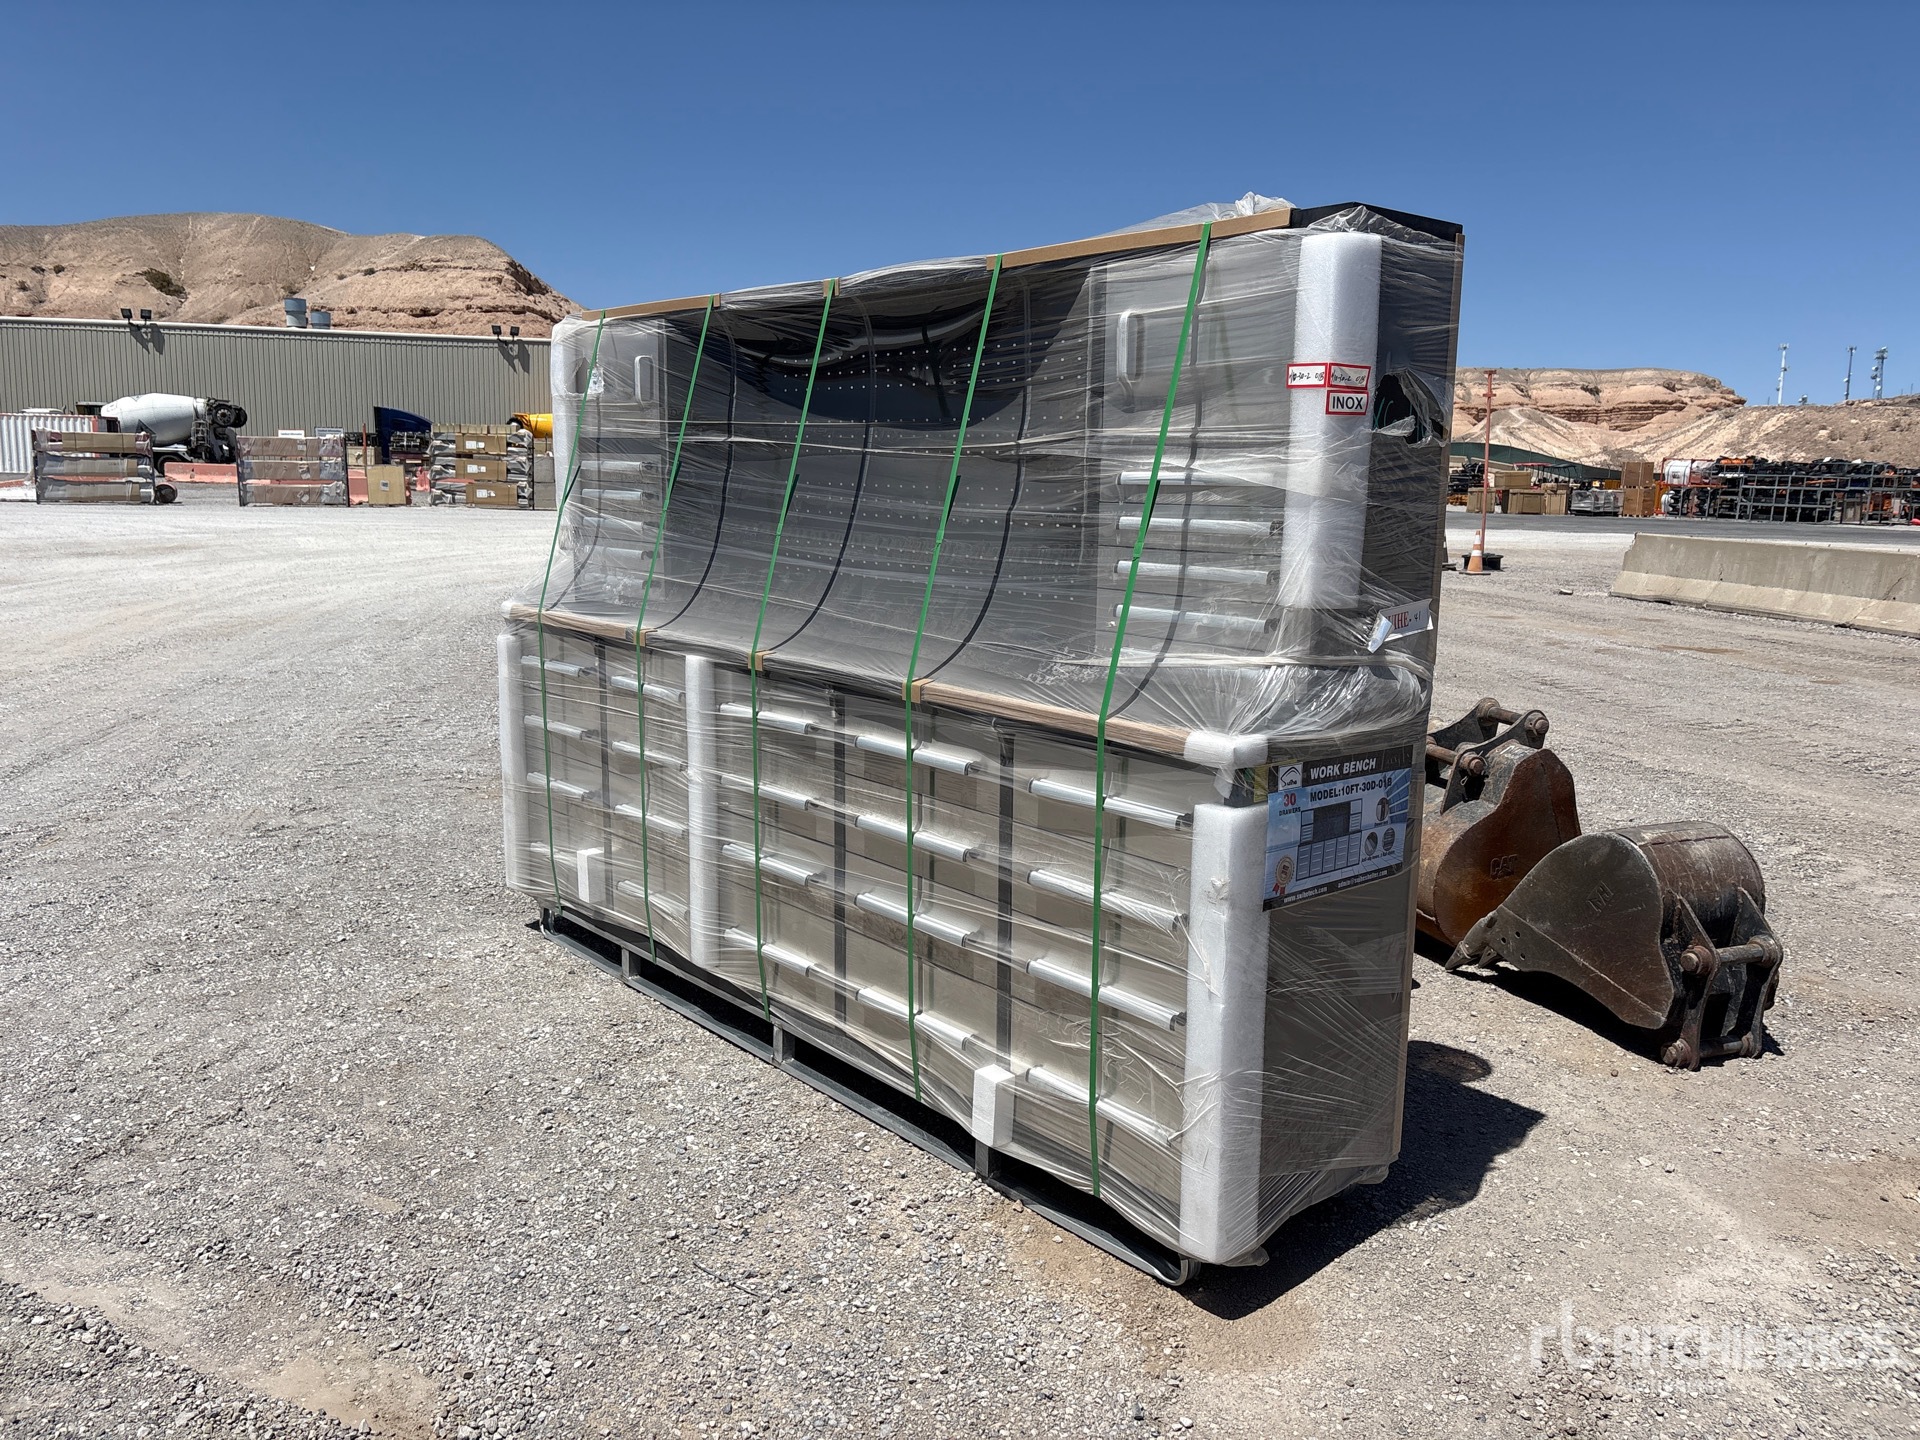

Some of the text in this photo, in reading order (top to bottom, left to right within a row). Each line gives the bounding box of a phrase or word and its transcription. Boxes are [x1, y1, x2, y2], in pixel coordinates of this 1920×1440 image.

[1332, 396, 1364, 410] INOX
[1310, 758, 1376, 779] WORK BENCH
[1283, 792, 1297, 807] 30
[1279, 807, 1301, 816] DRAWERS
[1490, 854, 1517, 878] CAT
